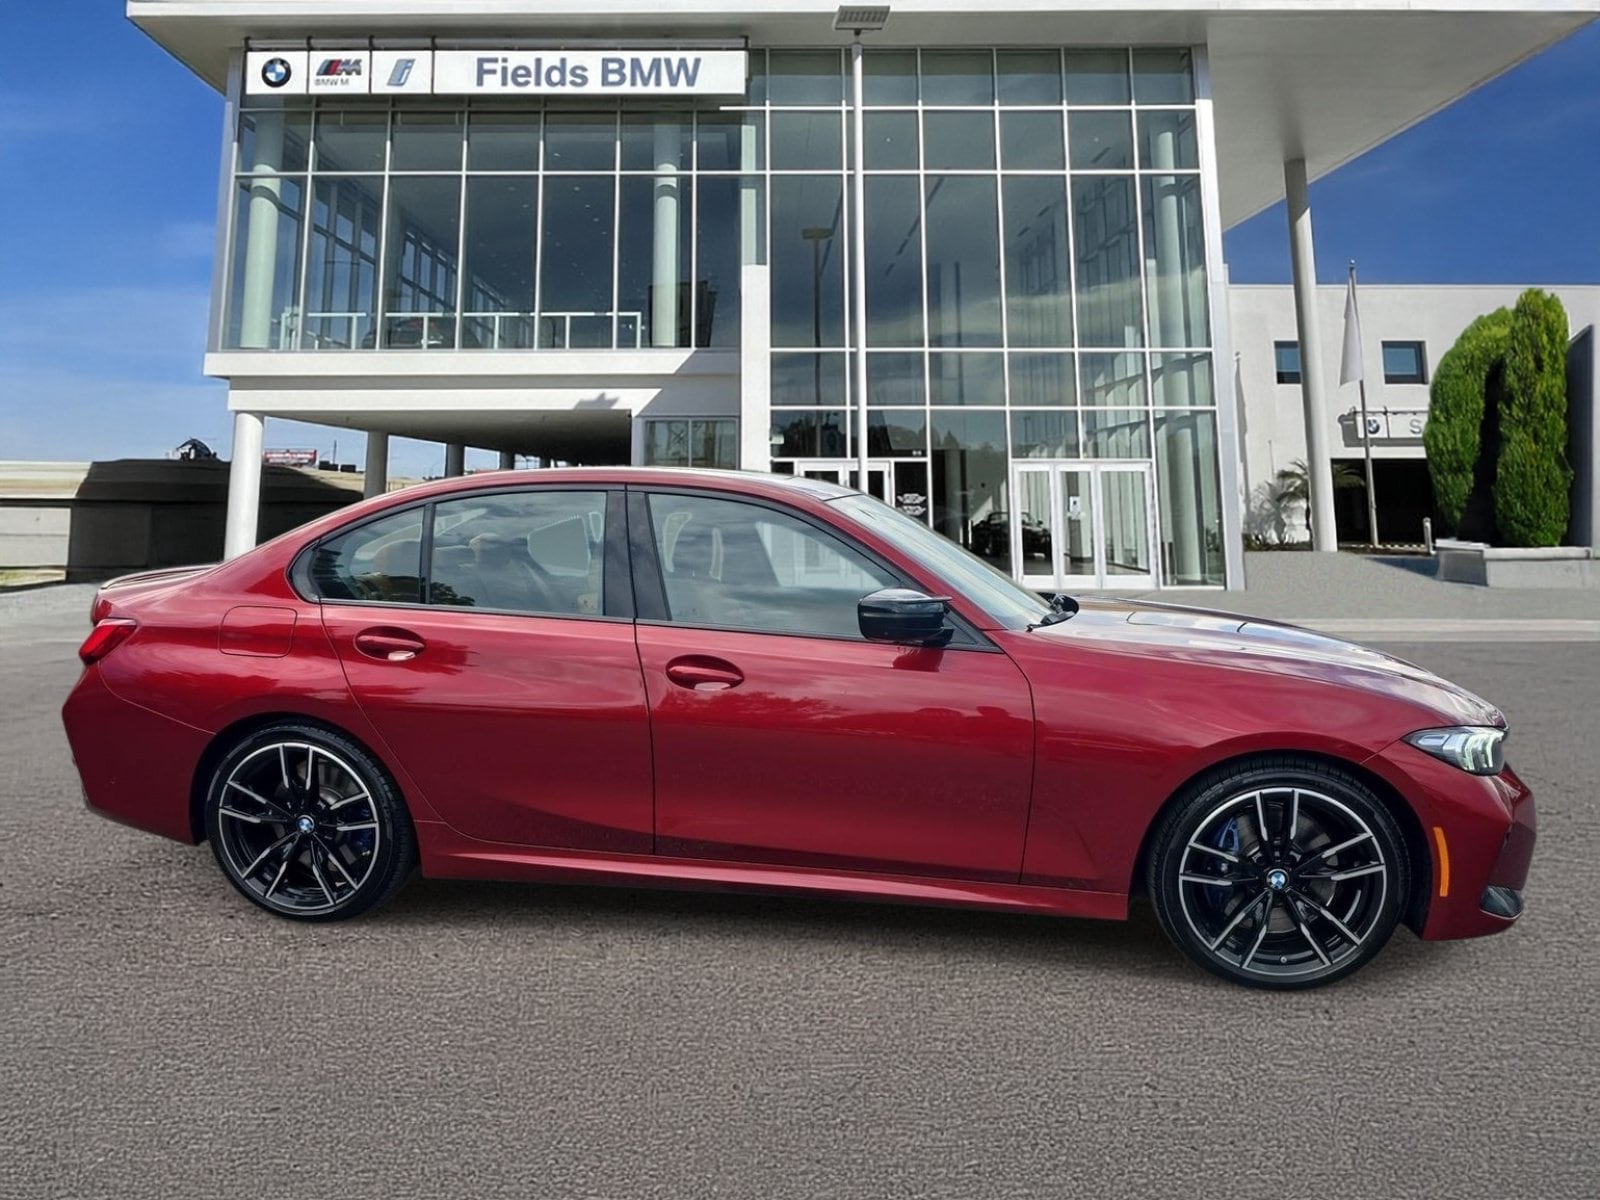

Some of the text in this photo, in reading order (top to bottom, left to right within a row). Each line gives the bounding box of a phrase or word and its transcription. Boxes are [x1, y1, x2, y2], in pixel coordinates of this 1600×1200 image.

[476, 57, 702, 87] Fields BMW
[314, 78, 338, 86] BMW
[1409, 418, 1423, 435] S
